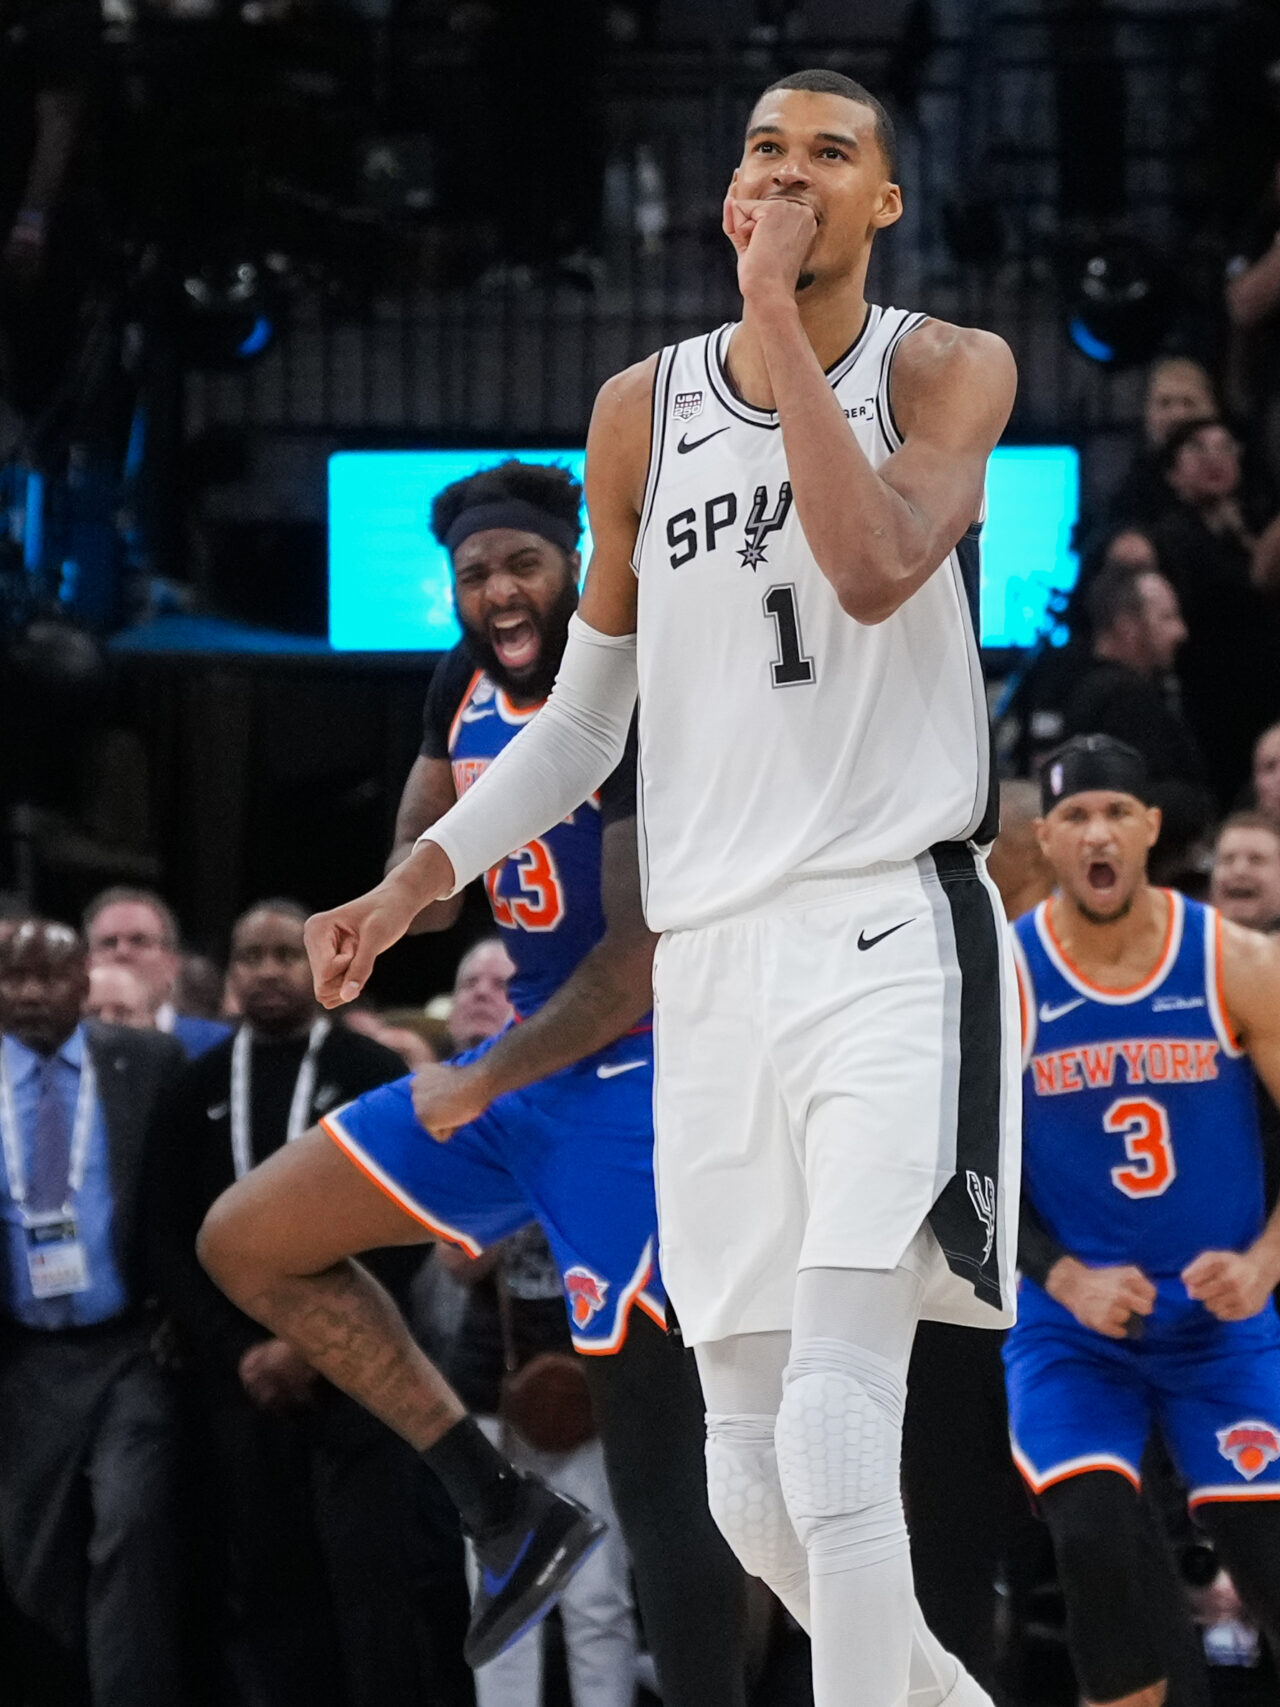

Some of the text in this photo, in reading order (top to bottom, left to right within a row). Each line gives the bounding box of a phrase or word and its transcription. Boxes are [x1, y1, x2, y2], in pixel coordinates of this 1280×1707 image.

[674, 405, 701, 416] 250
[677, 393, 701, 403] USA
[666, 481, 794, 572] SPU
[762, 582, 816, 689] 1
[1032, 1040, 1219, 1096] NEW YORK
[1103, 1097, 1176, 1199] 3
